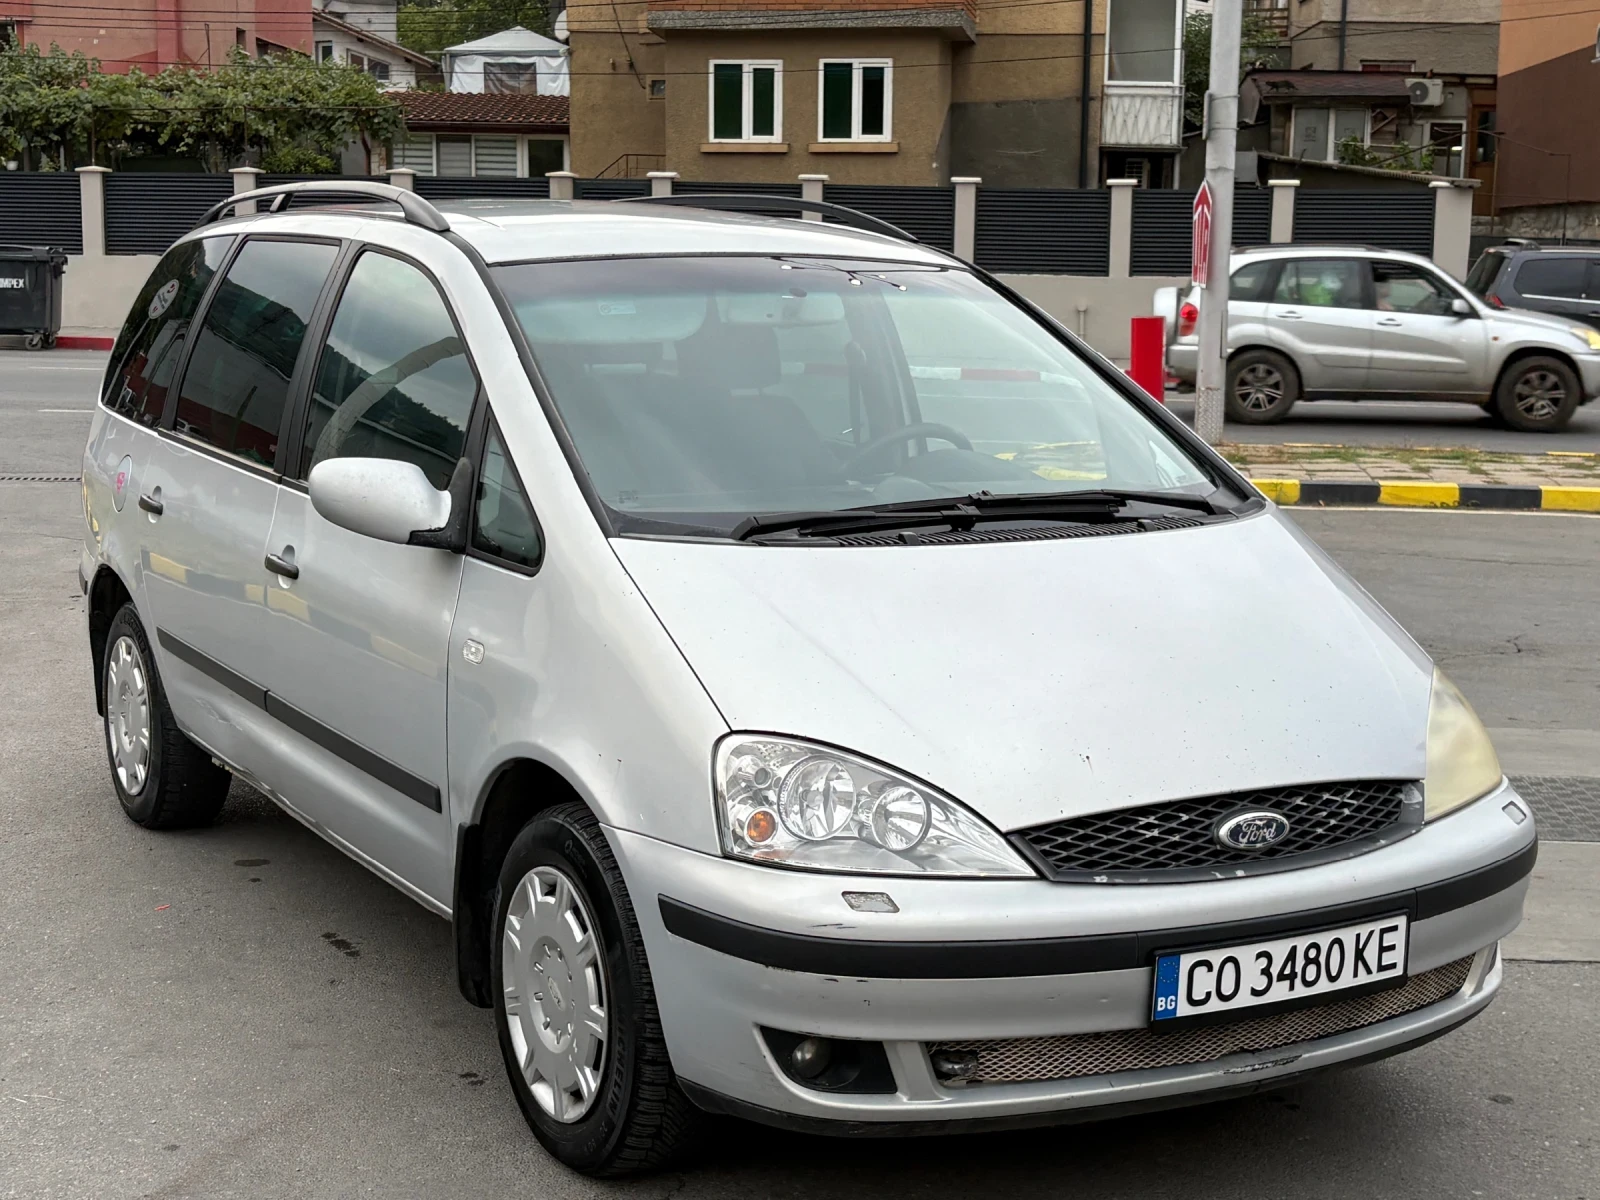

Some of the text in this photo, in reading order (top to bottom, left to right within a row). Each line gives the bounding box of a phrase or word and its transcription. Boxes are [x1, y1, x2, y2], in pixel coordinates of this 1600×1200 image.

[1239, 820, 1277, 843] Ford
[1186, 924, 1399, 1006] CO 3480 KE
[1157, 996, 1176, 1011] BG
